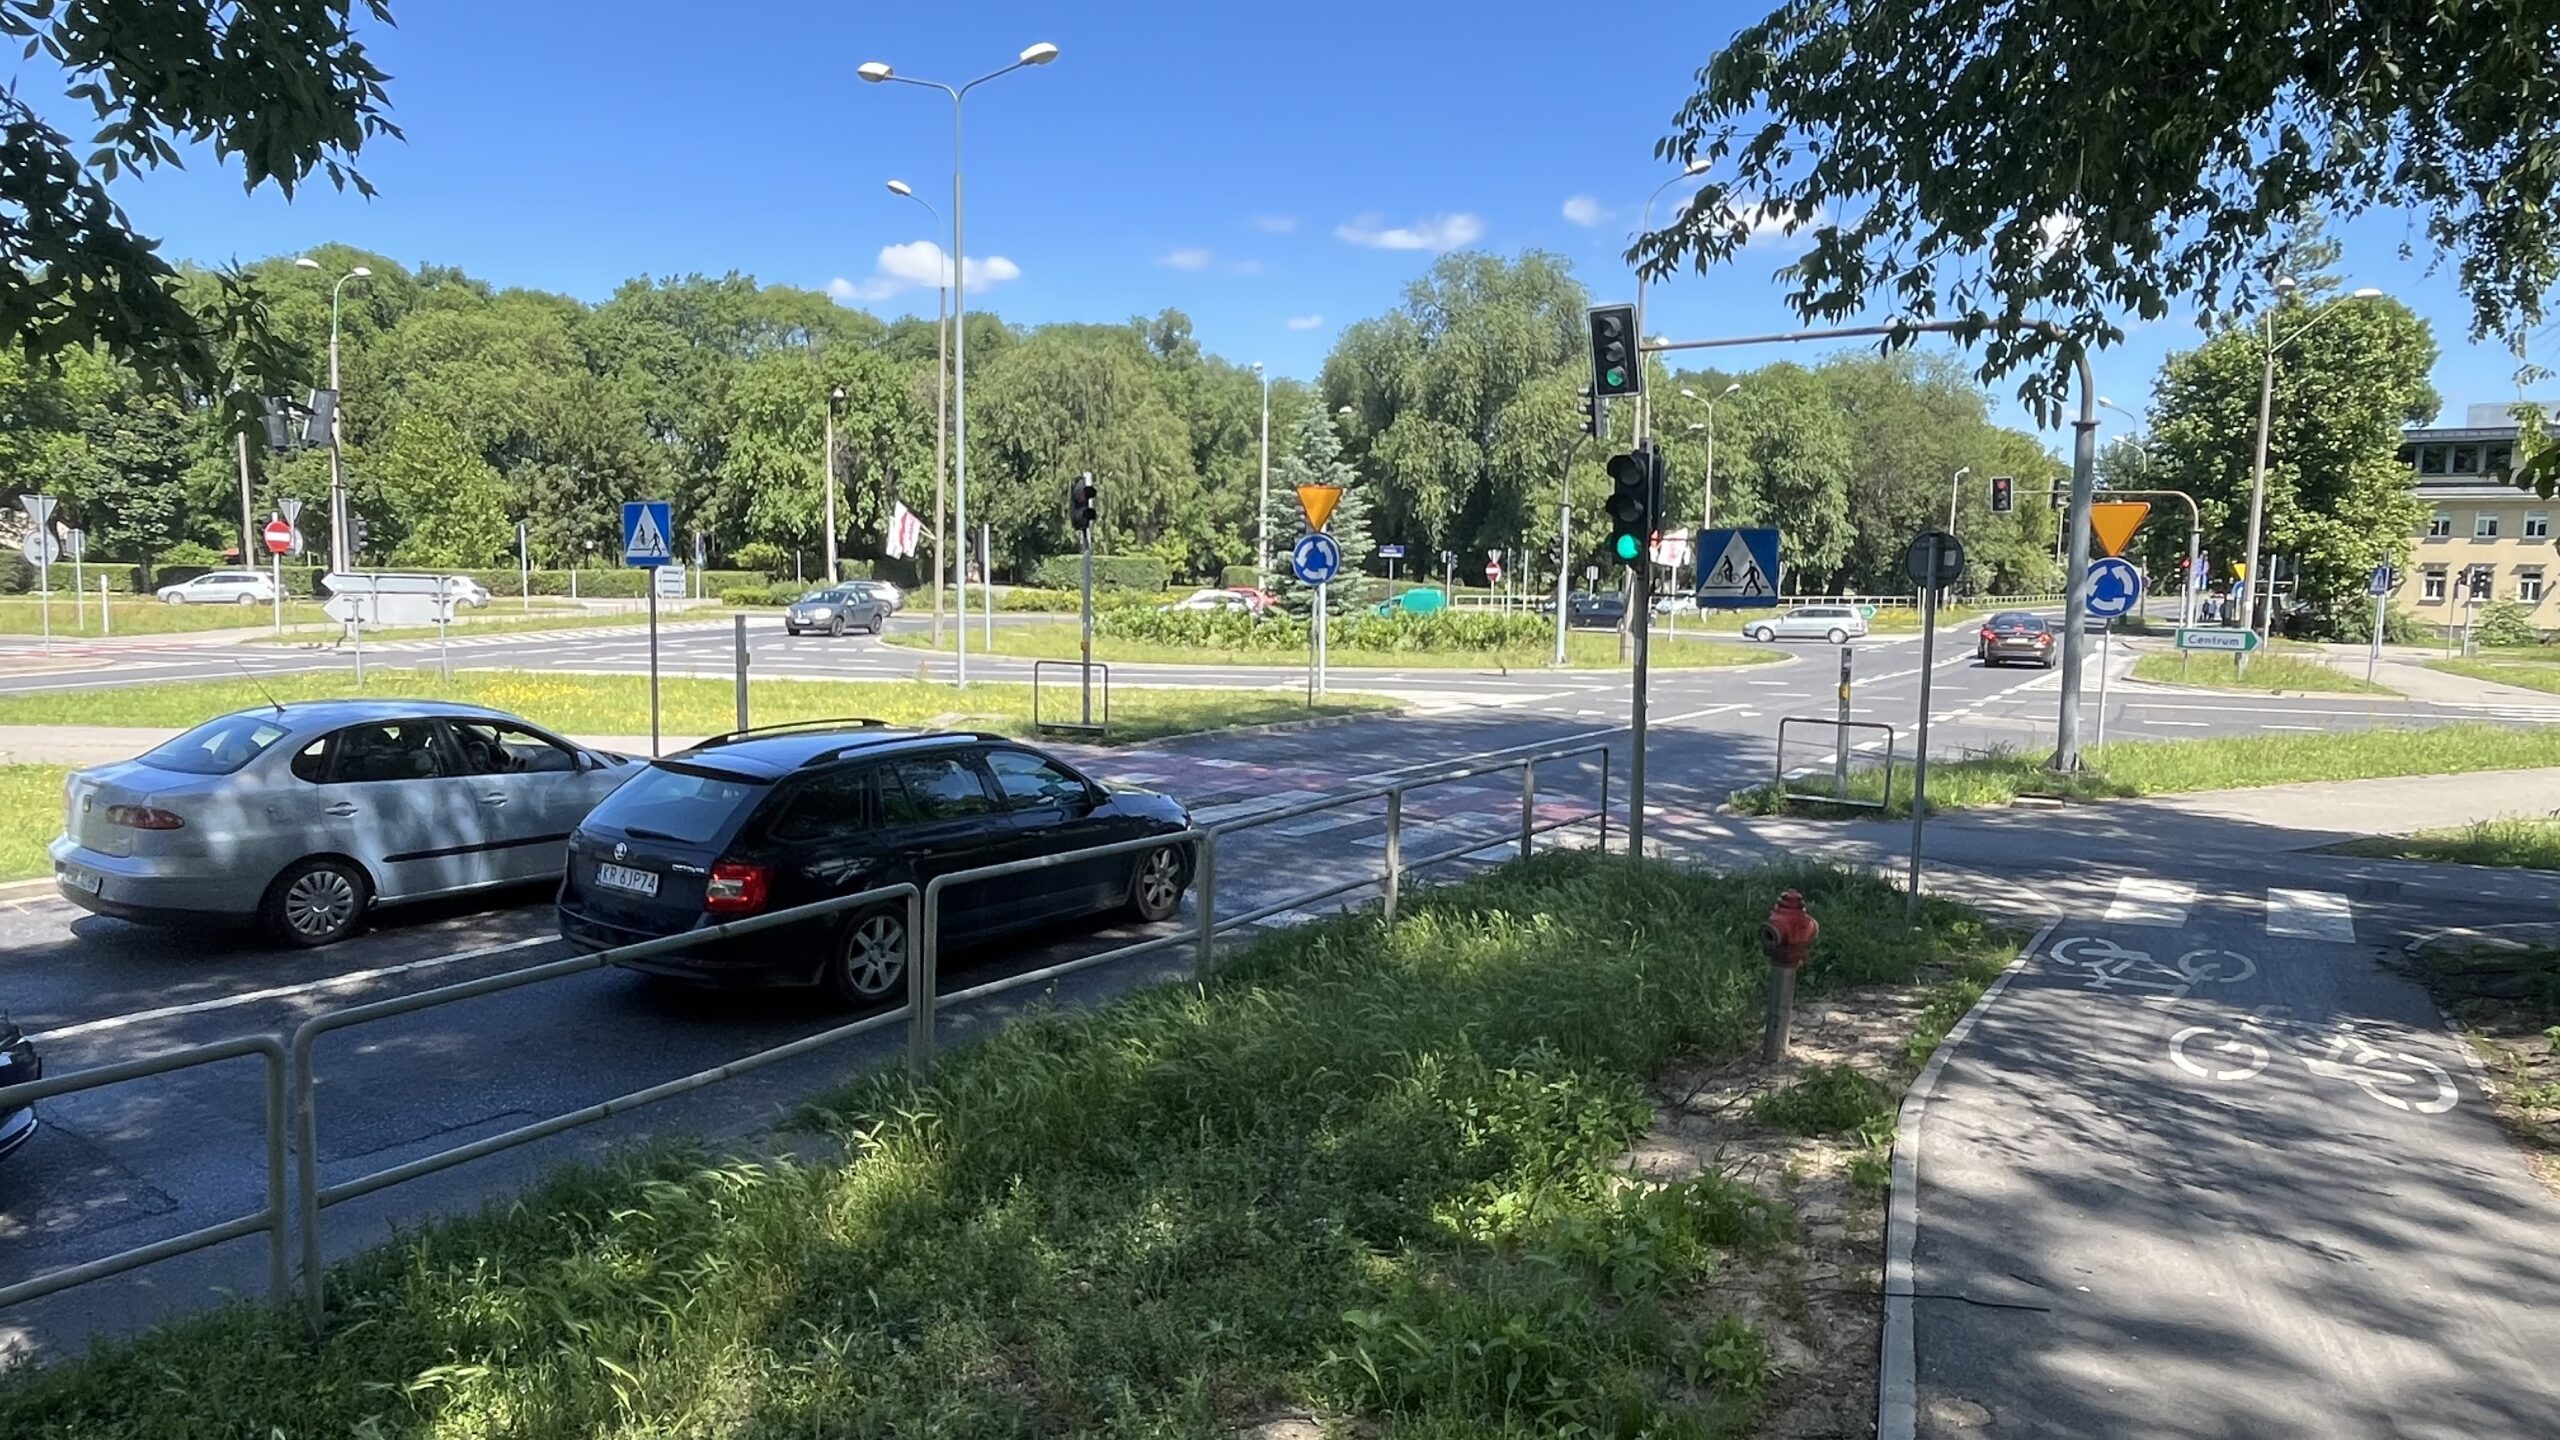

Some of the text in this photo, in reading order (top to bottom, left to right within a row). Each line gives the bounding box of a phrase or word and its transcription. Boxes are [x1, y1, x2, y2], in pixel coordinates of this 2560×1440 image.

[2187, 633, 2239, 646] Centrum
[603, 865, 656, 891] KR 6JP74
